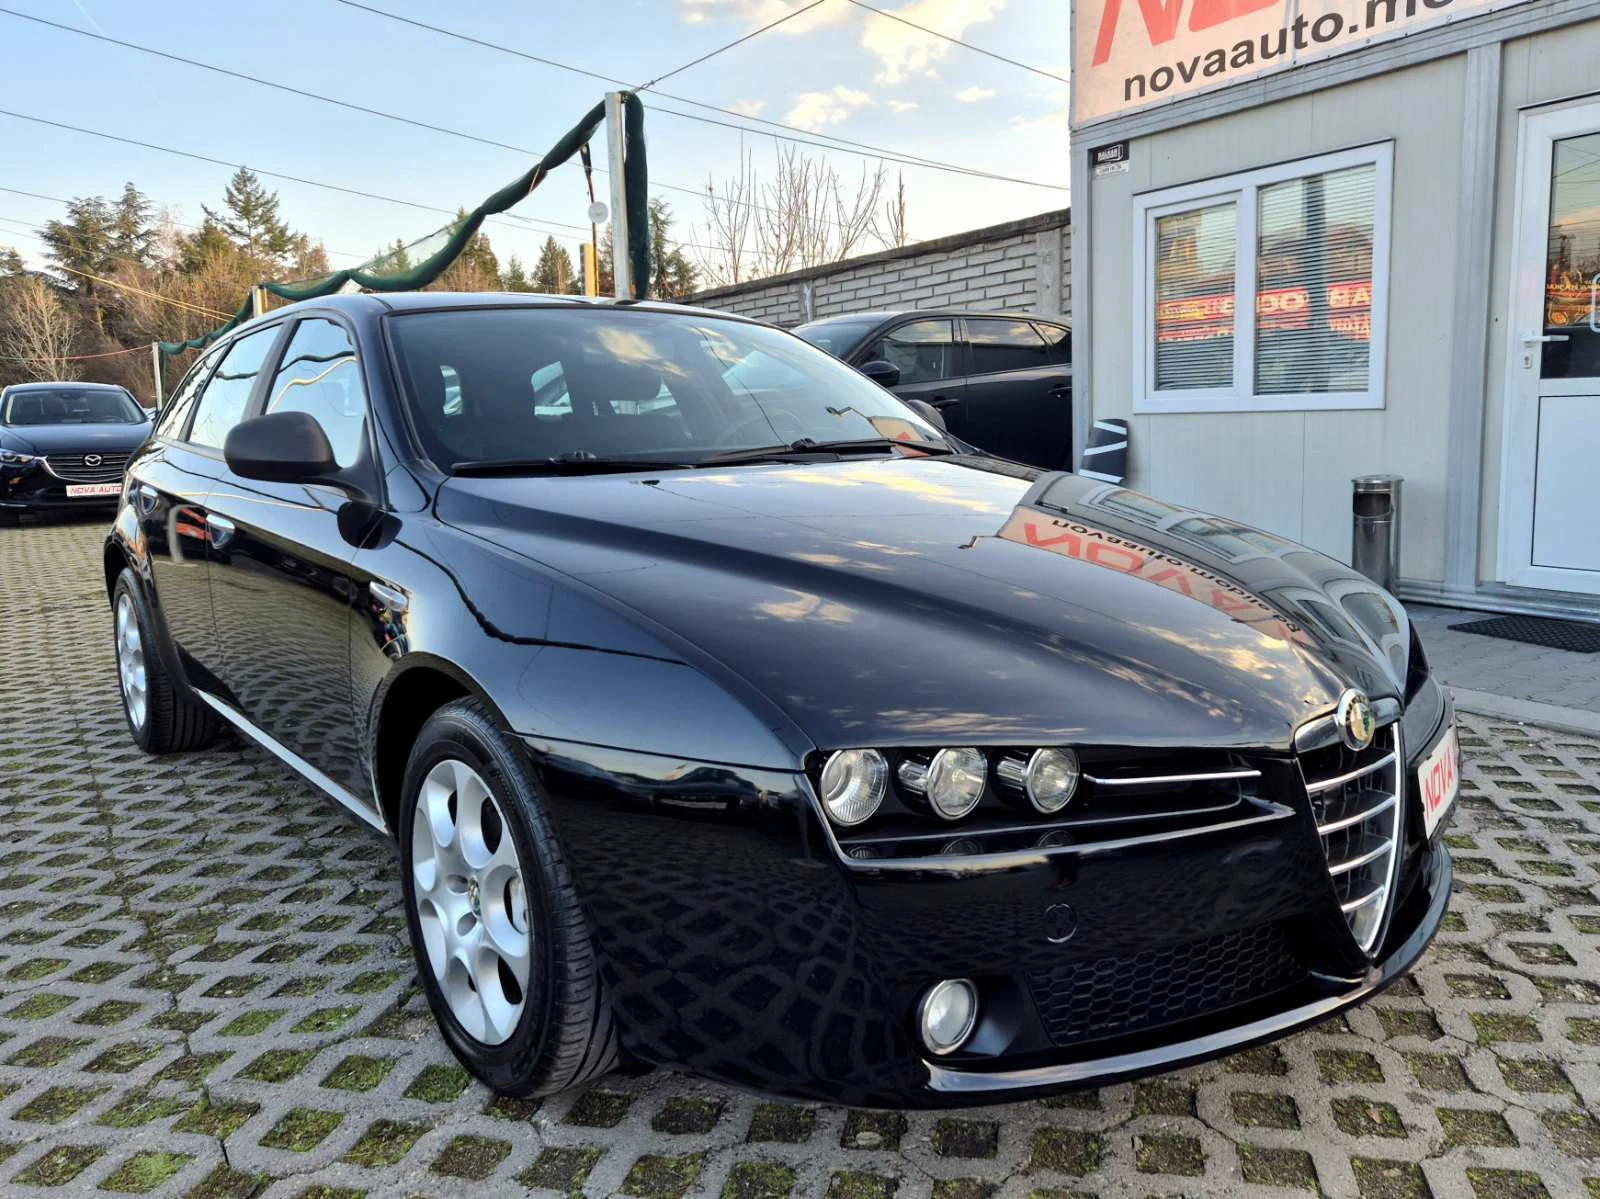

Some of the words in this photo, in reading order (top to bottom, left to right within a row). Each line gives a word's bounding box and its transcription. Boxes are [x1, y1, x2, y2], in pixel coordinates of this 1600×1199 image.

[1124, 0, 1450, 102] novaauto.m
[71, 486, 96, 494] NOVA
[1424, 745, 1454, 821] NOVA
